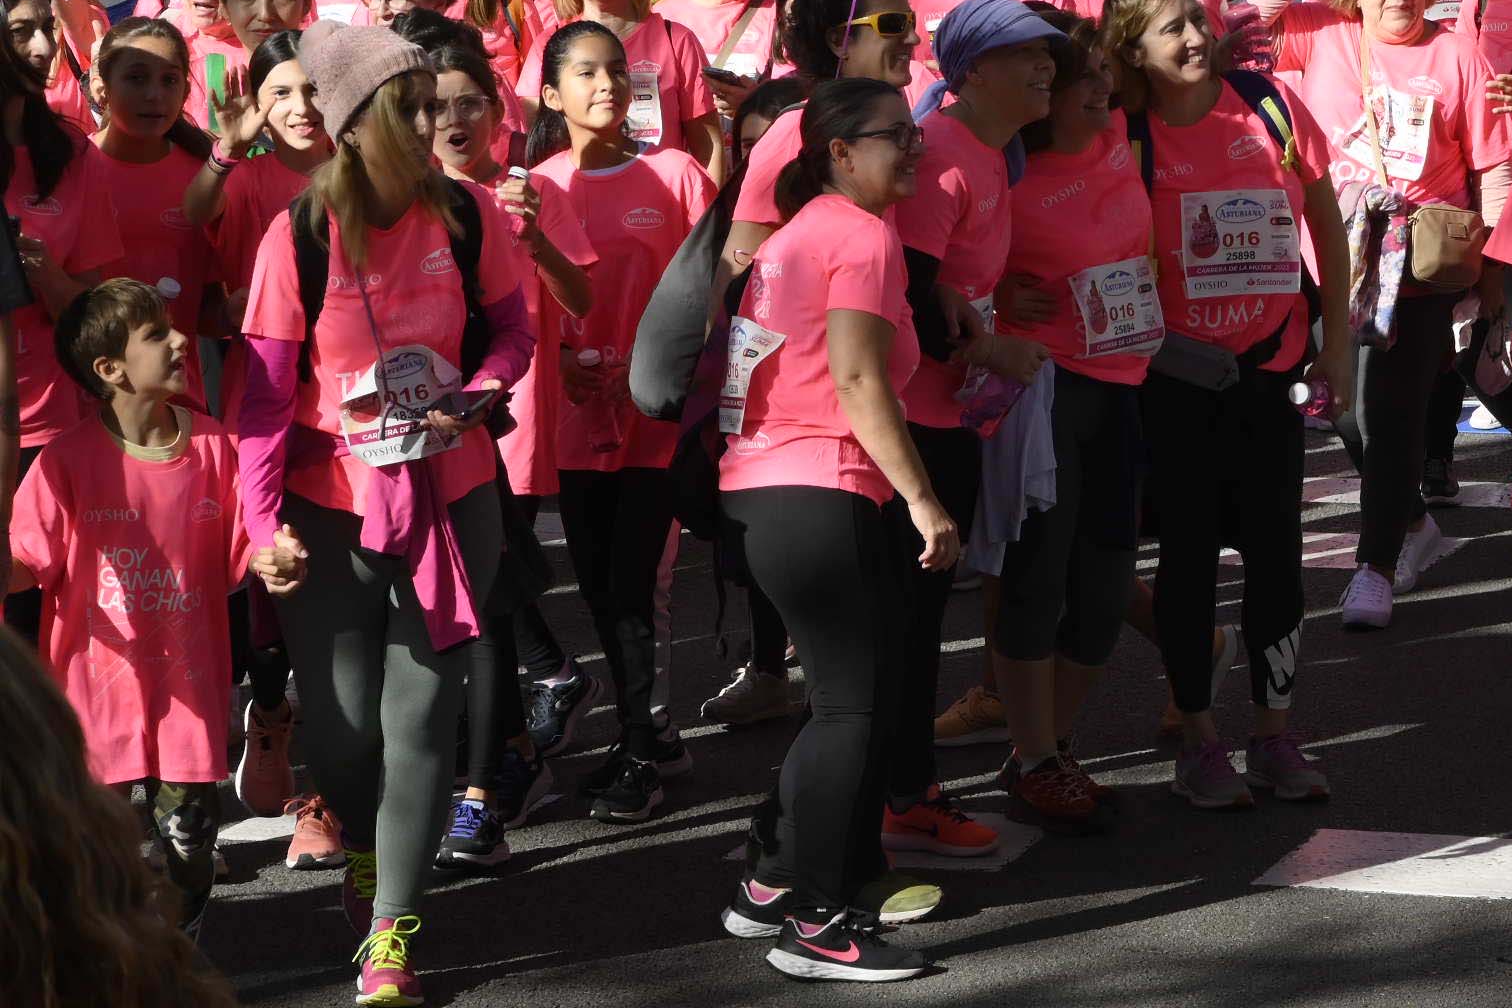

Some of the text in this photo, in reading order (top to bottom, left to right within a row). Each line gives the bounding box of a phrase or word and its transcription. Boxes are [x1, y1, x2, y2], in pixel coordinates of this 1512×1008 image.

[1222, 230, 1261, 249] 016
[1226, 250, 1256, 261] 25898
[1194, 277, 1293, 292] OYSHO Santander
[1108, 301, 1136, 322] 016
[83, 508, 141, 522] OYSHO
[100, 546, 149, 569] HOY
[100, 567, 185, 591] GANAN
[98, 589, 136, 614] LAS
